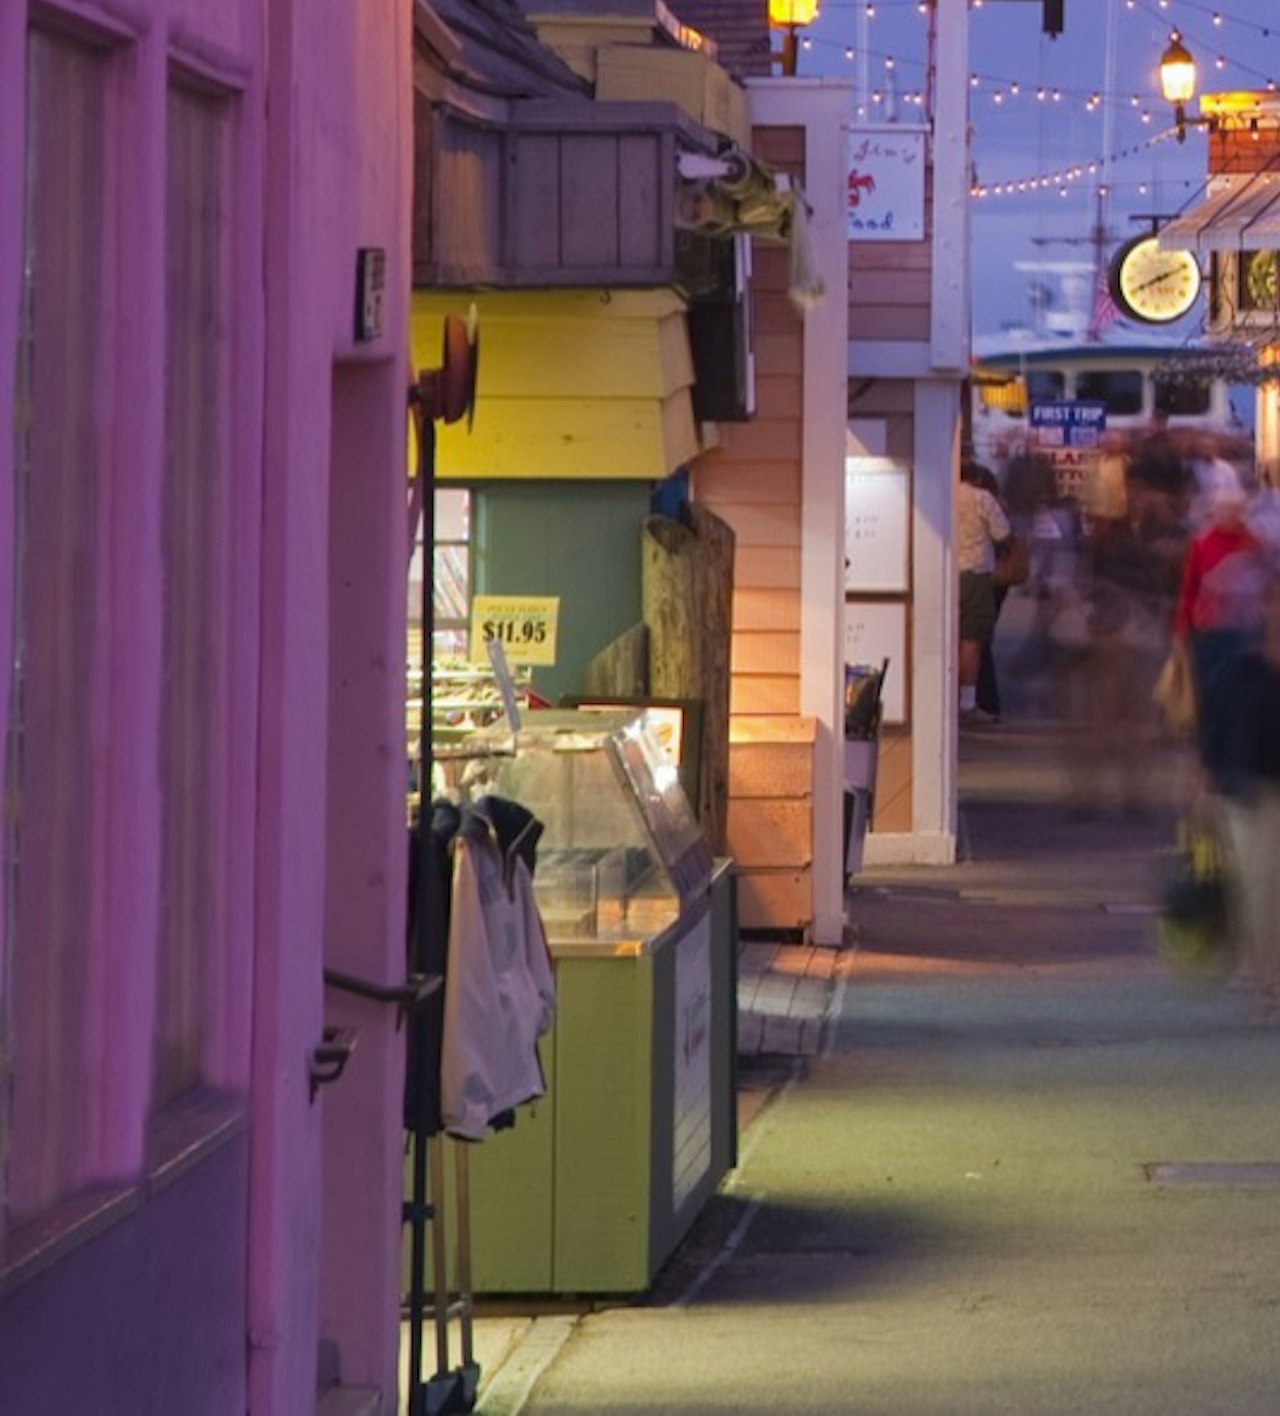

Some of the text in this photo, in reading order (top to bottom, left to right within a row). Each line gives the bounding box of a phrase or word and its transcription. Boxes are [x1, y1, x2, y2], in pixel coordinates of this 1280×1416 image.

[848, 211, 894, 231] ood
[1033, 406, 1104, 421] FIRST TRIP
[482, 620, 547, 644] $11.95
